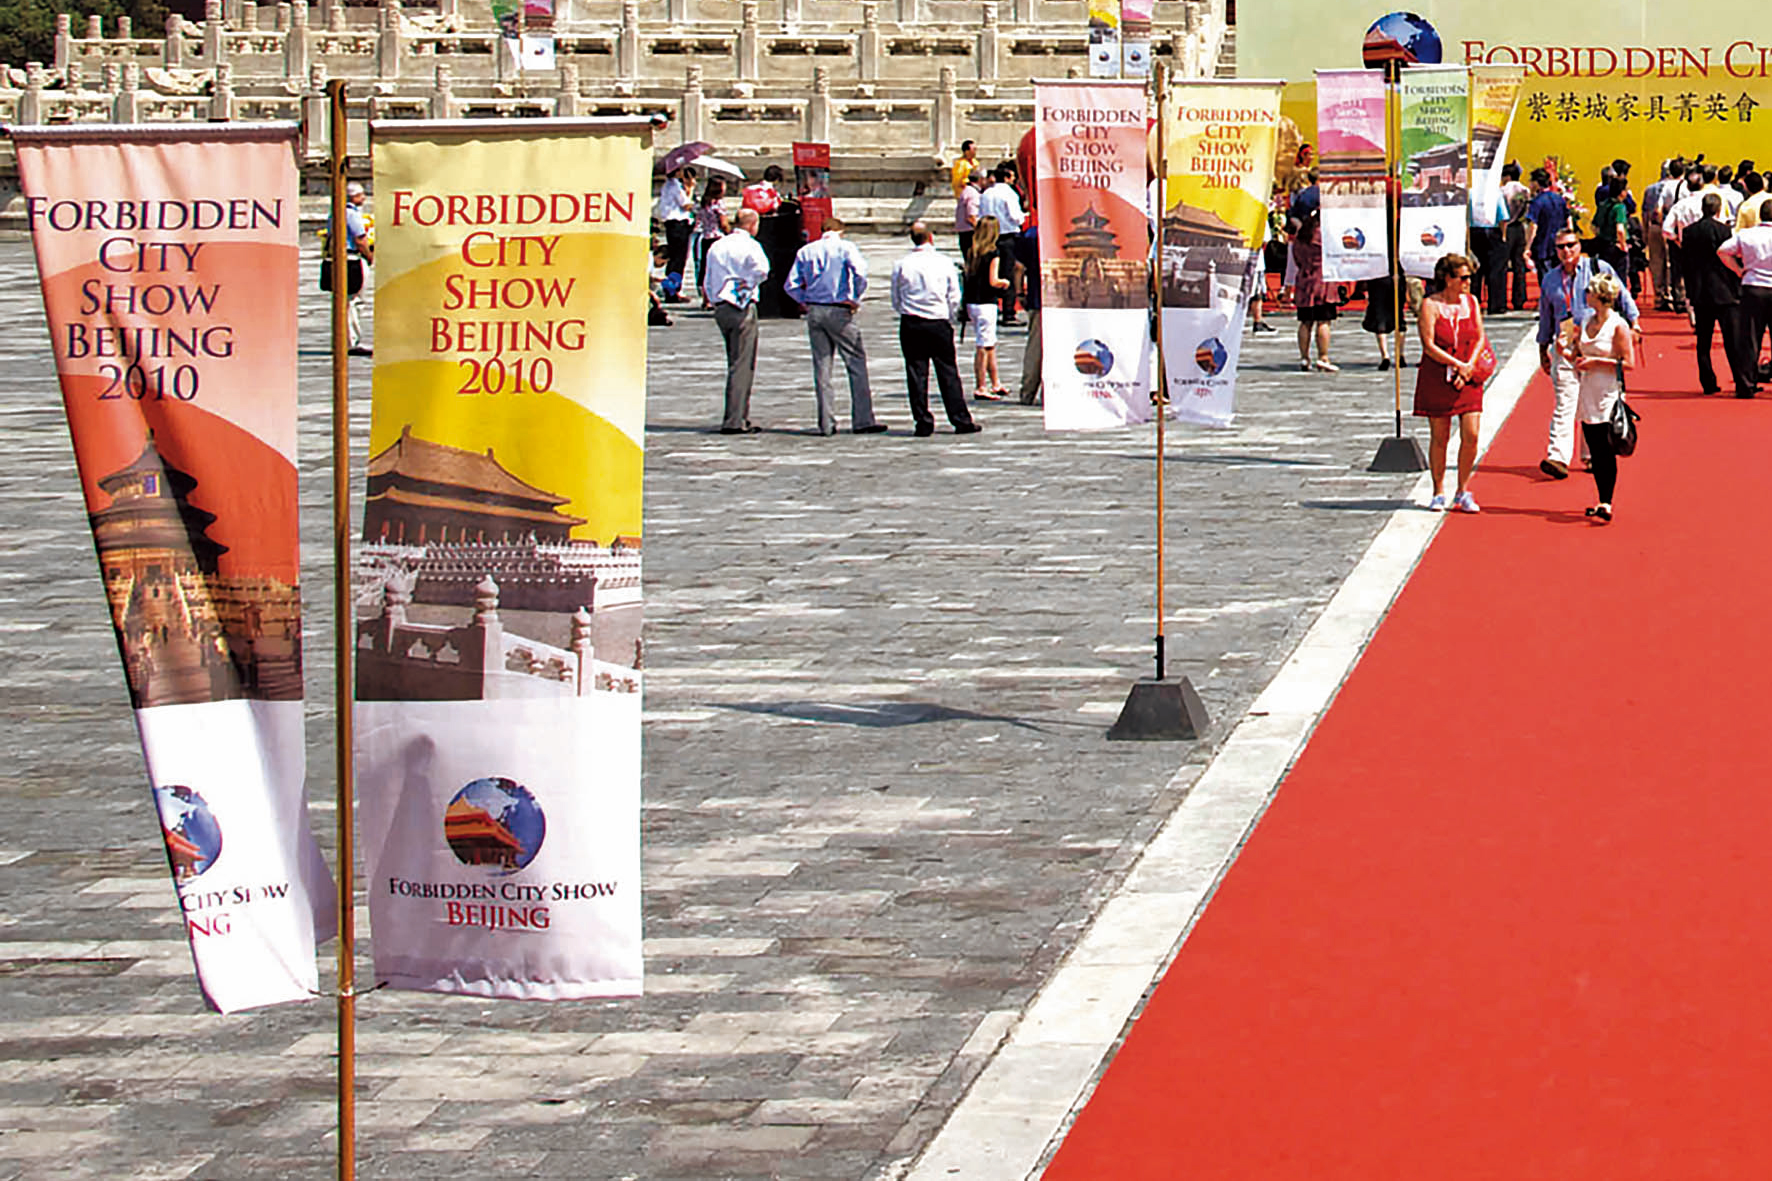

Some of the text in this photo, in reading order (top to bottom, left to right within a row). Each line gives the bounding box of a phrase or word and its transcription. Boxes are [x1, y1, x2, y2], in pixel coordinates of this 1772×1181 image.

[1461, 40, 1712, 78] FORBIDDEN
[1042, 106, 1142, 123] FORBIDDEN
[1177, 106, 1274, 122] FORBIDDEN
[1527, 91, 1759, 123] 紫禁城家具菁英會
[1072, 124, 1111, 139] CITY
[1204, 124, 1245, 139] CITY
[1065, 140, 1119, 156] SHOW
[1198, 140, 1250, 155] SHOW
[1059, 157, 1124, 174] BEIJING
[1190, 157, 1253, 174] BEIJING
[1072, 174, 1111, 189] 2010
[1202, 174, 1241, 189] 2010
[26, 197, 283, 231] FORBIDDEN
[391, 191, 634, 227] FORBIDDEN
[99, 236, 205, 273] CITY
[462, 231, 563, 267] CITY
[80, 278, 220, 316] SHOW
[443, 274, 576, 310] SHOW
[66, 323, 234, 365] BEIJING
[430, 317, 587, 357] BEIJING
[97, 365, 200, 401] 2010
[457, 357, 554, 394] 2010
[389, 878, 618, 901] FORBIDDEN CITY SHOW
[446, 901, 550, 930] BEIJING
